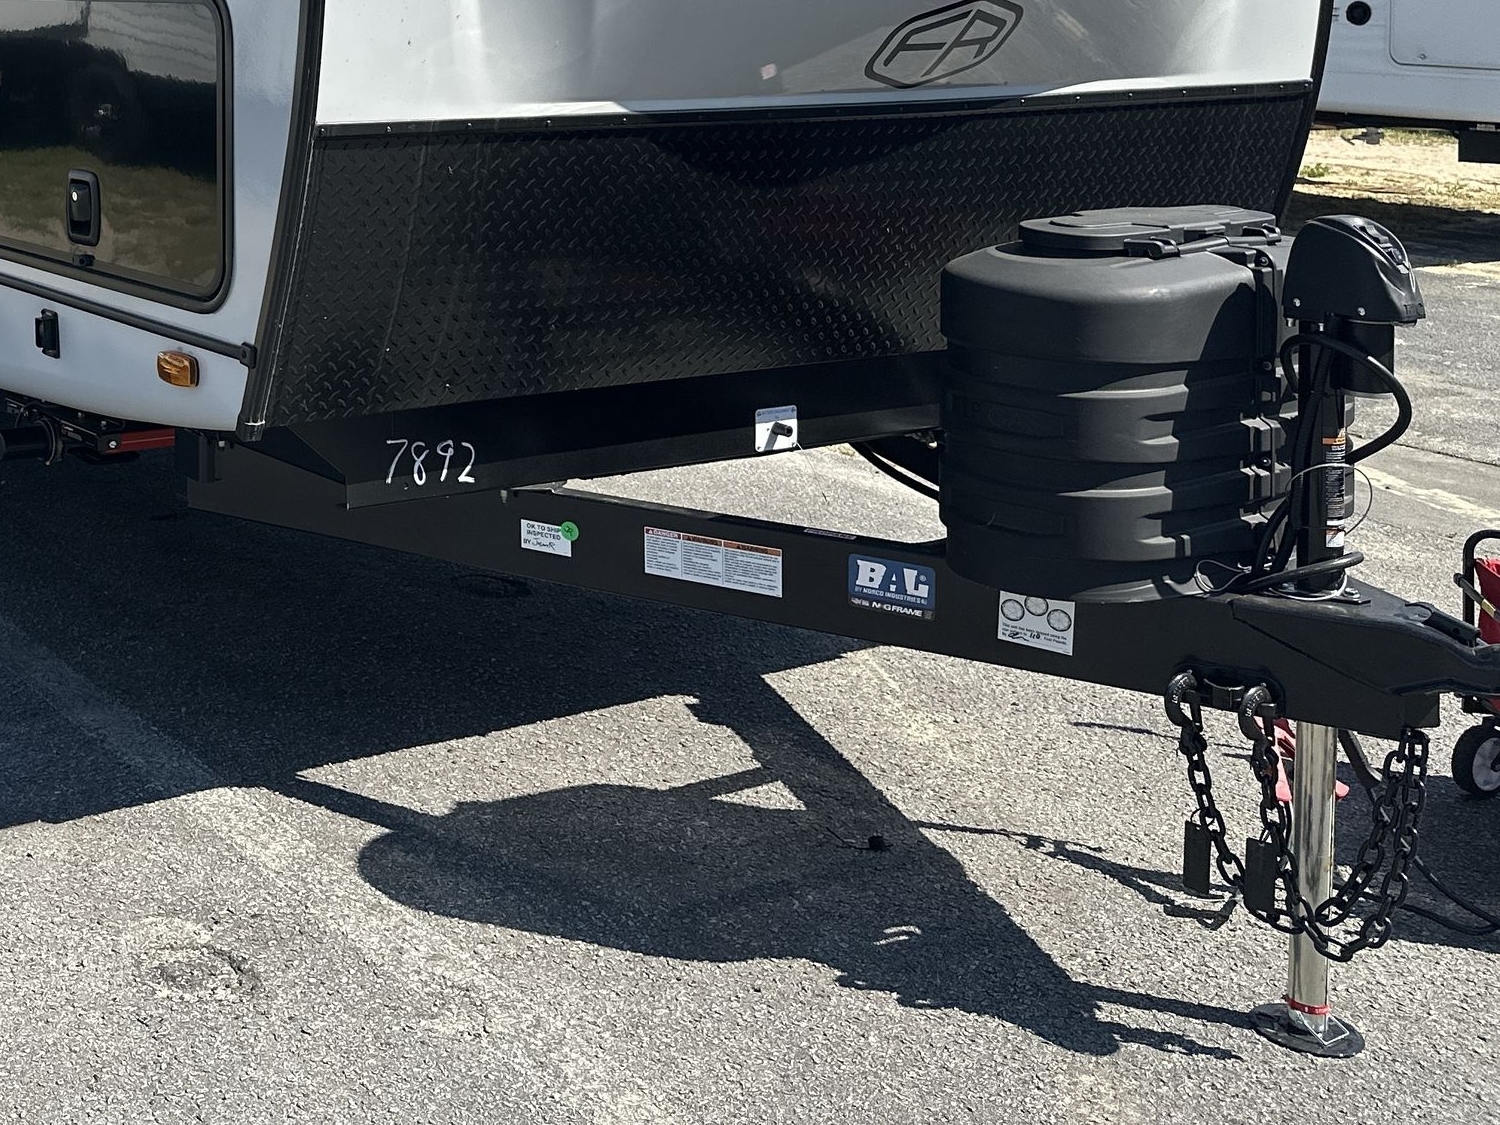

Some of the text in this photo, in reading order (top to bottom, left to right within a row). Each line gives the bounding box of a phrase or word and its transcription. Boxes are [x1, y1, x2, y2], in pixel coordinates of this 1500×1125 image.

[386, 439, 475, 486] 7892
[526, 522, 536, 530] OK
[526, 529, 561, 541] INSPECTED
[856, 559, 929, 598] BAL
